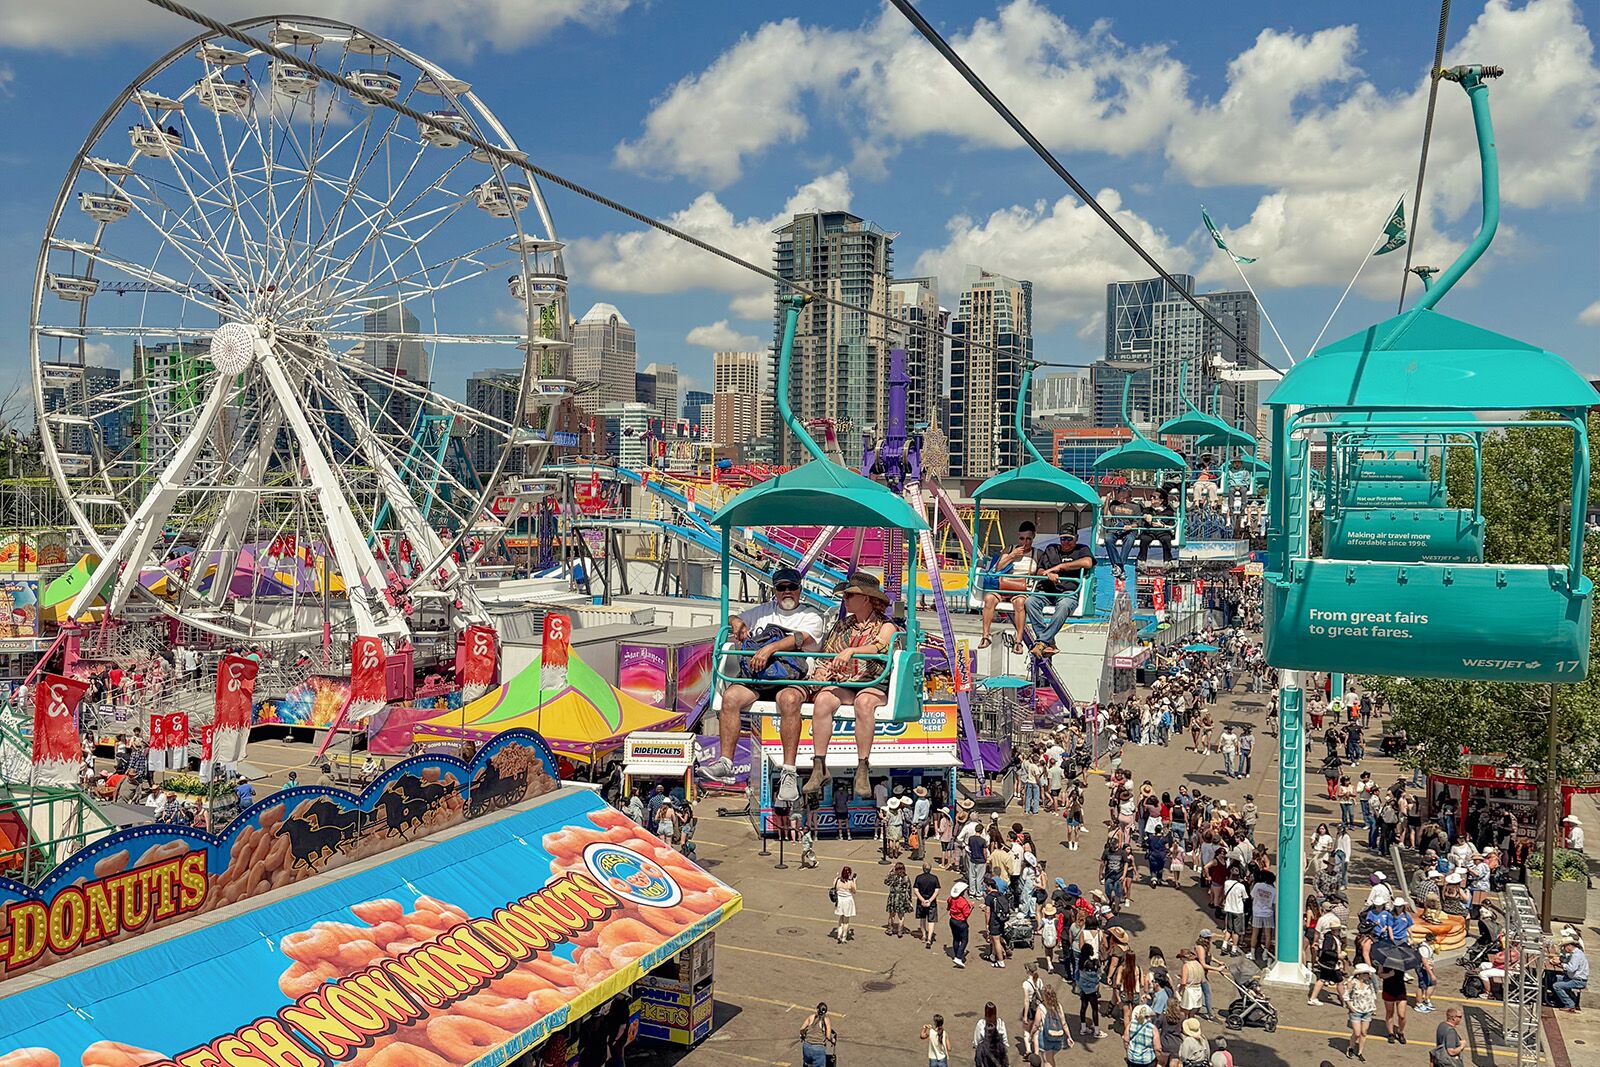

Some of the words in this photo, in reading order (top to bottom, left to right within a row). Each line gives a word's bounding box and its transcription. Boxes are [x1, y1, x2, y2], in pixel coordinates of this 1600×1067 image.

[1347, 531, 1376, 541] Making
[1388, 532, 1410, 540] travel
[1347, 539, 1386, 547] affordable
[1466, 555, 1479, 563] 16
[1309, 609, 1348, 621] From
[1350, 610, 1391, 625] great
[1394, 610, 1429, 624] fairs
[549, 618, 563, 640] CS
[1309, 624, 1324, 635] to
[1328, 625, 1368, 638] great
[1371, 626, 1413, 639] fares.
[362, 641, 379, 669] CS
[1462, 658, 1525, 670] WESTJET
[1555, 660, 1580, 673] 17
[633, 746, 651, 755] RIDE
[652, 747, 682, 755] TICKETS
[640, 881, 666, 897] NOW
[280, 965, 422, 1062] NOW
[384, 924, 511, 1007] MINI
[468, 872, 621, 961] DONUTS
